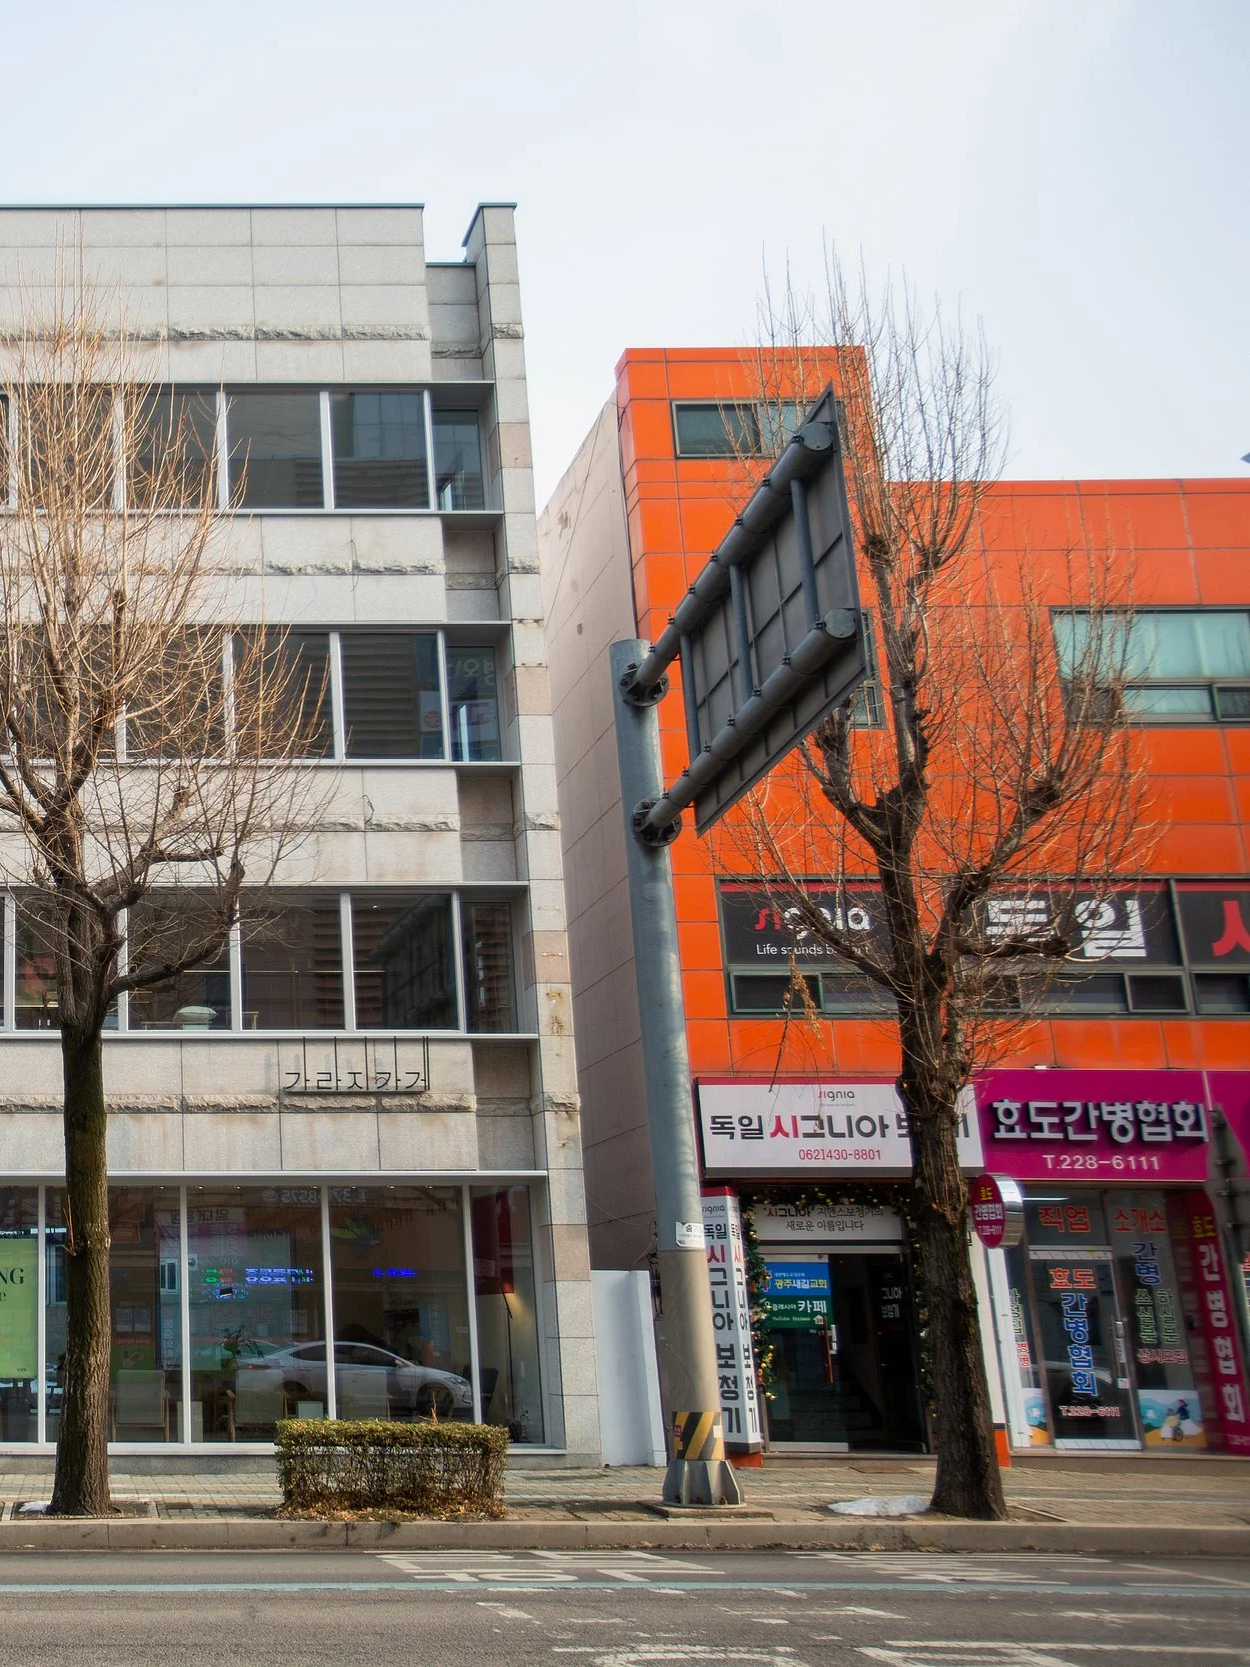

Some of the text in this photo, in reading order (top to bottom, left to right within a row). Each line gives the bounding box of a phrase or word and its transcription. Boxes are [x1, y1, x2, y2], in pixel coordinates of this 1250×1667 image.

[756, 944, 778, 955] Life
[818, 1090, 855, 1102] signia
[710, 1114, 764, 1140] 독일
[770, 1114, 889, 1139] 시그니아
[992, 1098, 1210, 1144] 효도간병협회
[1042, 1154, 1160, 1170] T.228-6111
[980, 1186, 993, 1201] 효도
[974, 1203, 1003, 1221] 간병협회
[1038, 1206, 1168, 1233] 직업 소개소
[704, 1223, 728, 1240] 독일
[786, 1220, 864, 1231] 새로운 이름입니다
[1192, 1216, 1216, 1238] 효도
[1133, 1242, 1162, 1285] 간병
[707, 1244, 734, 1331] 시그니아
[1050, 1267, 1097, 1289] 효도
[798, 1300, 827, 1313] 카페
[1061, 1292, 1098, 1396] 간병협회
[715, 1343, 742, 1434] 보청기
